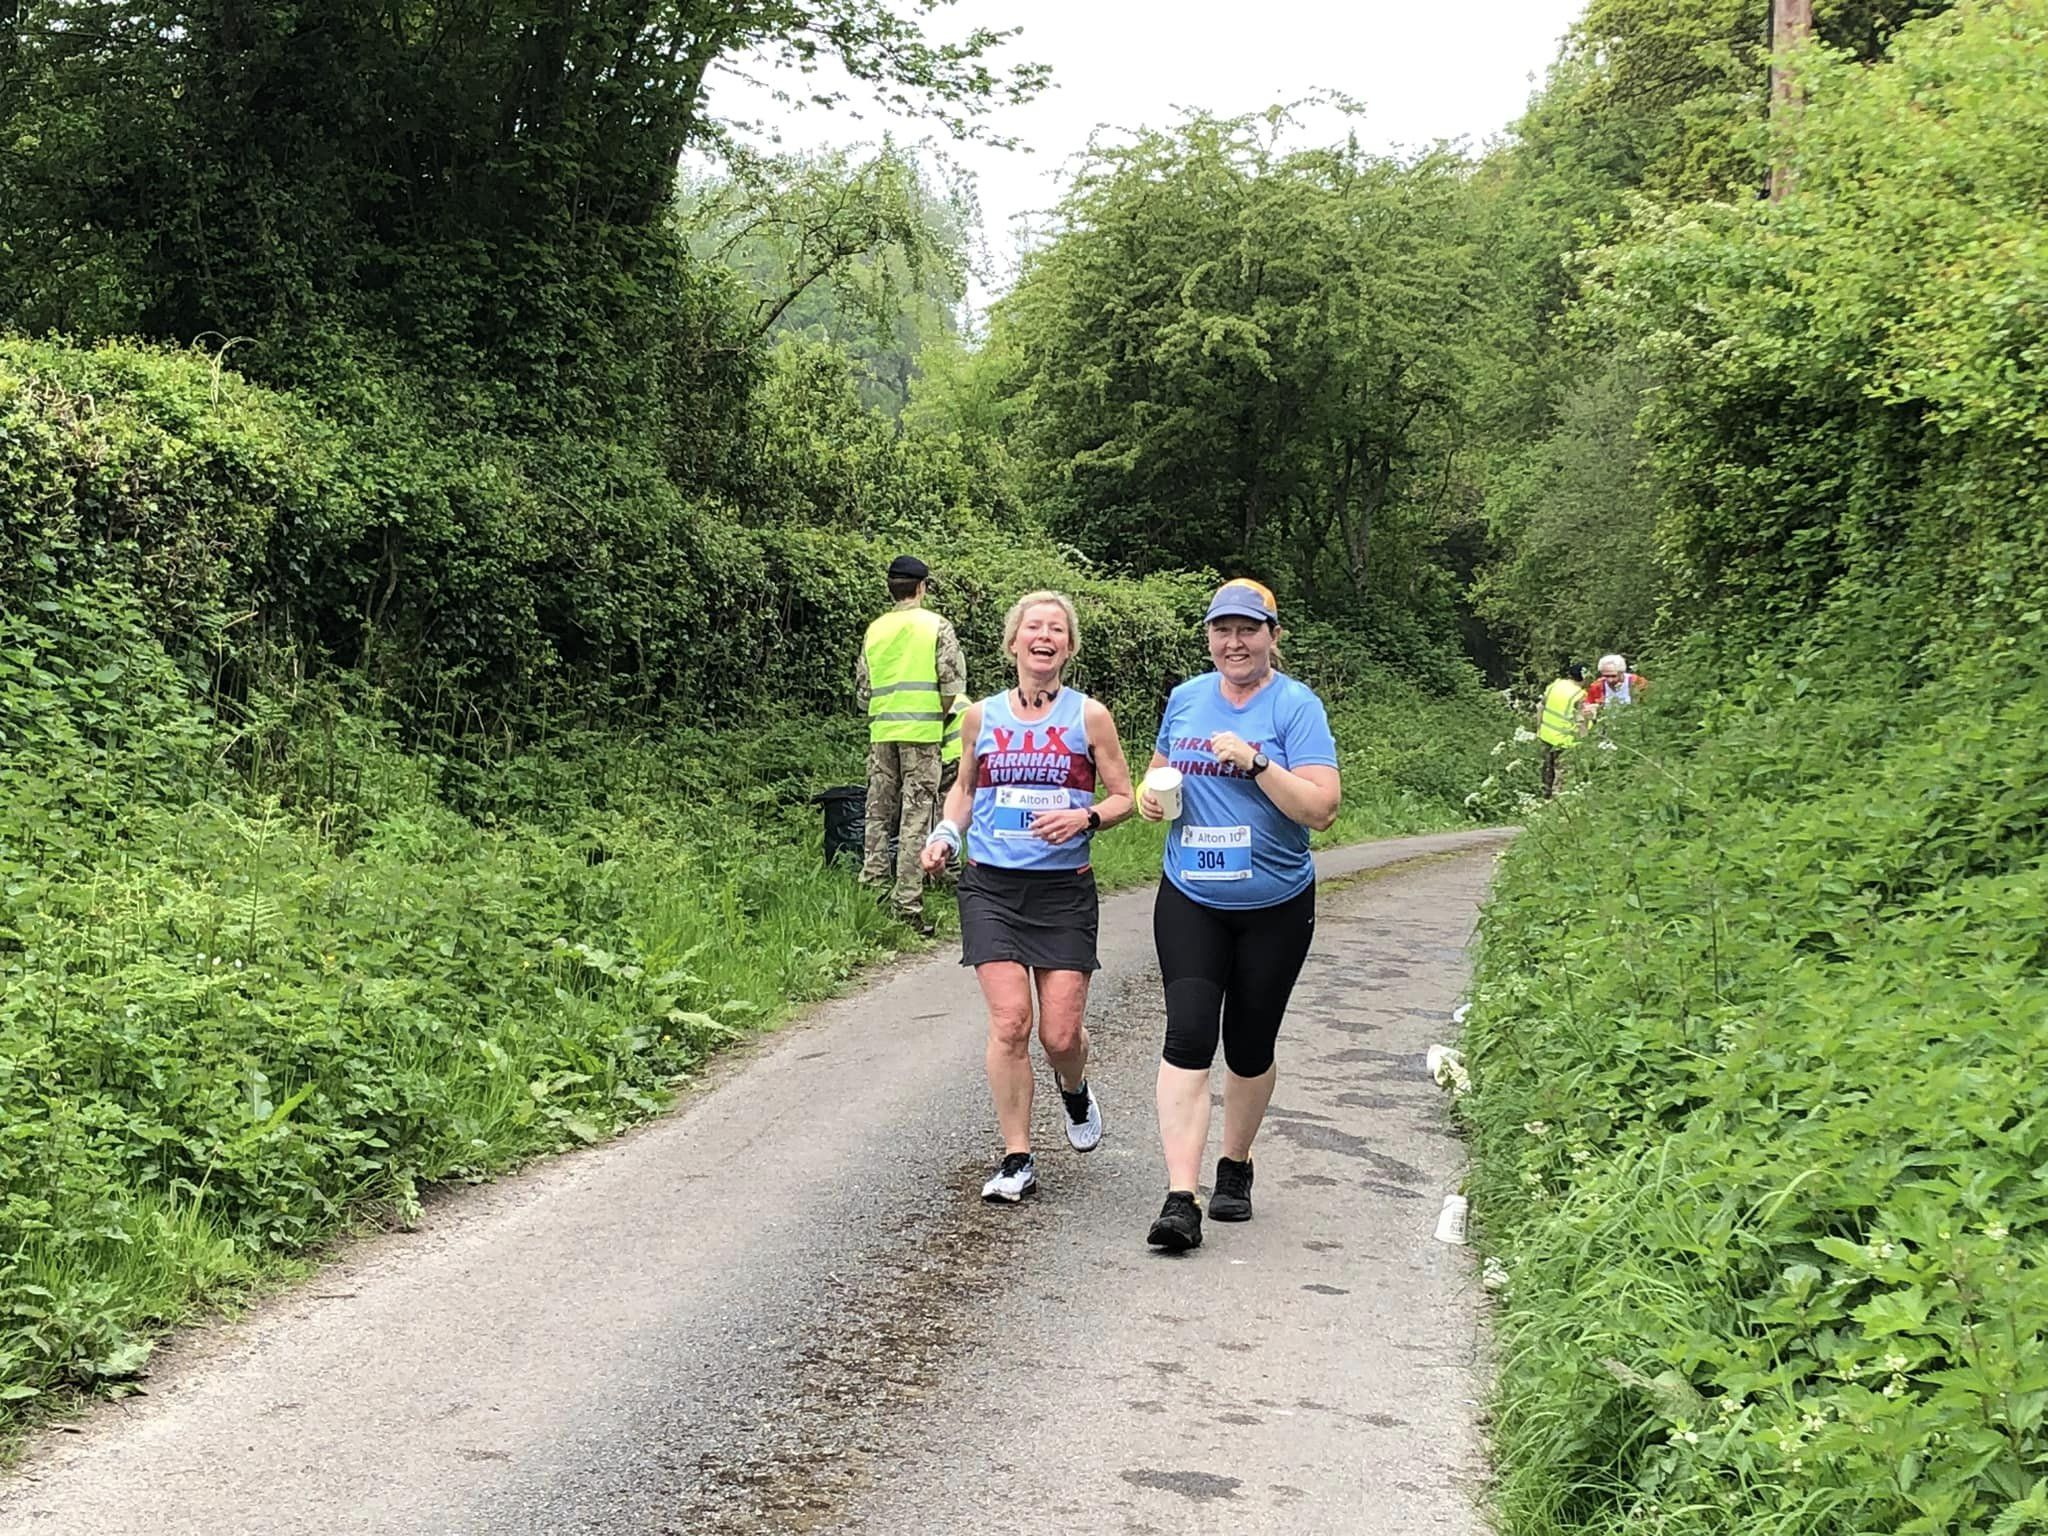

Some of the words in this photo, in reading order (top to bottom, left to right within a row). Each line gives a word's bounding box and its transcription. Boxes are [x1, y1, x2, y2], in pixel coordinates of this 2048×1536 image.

[987, 752, 1071, 769] FARNHAM
[990, 768, 1069, 784] RUNNERS
[1019, 794, 1049, 805] Alton
[1052, 794, 1063, 804] 10
[1020, 811, 1035, 828] 15
[1198, 832, 1226, 843] Alton
[1230, 832, 1242, 842] 10
[1197, 850, 1225, 869] 304
